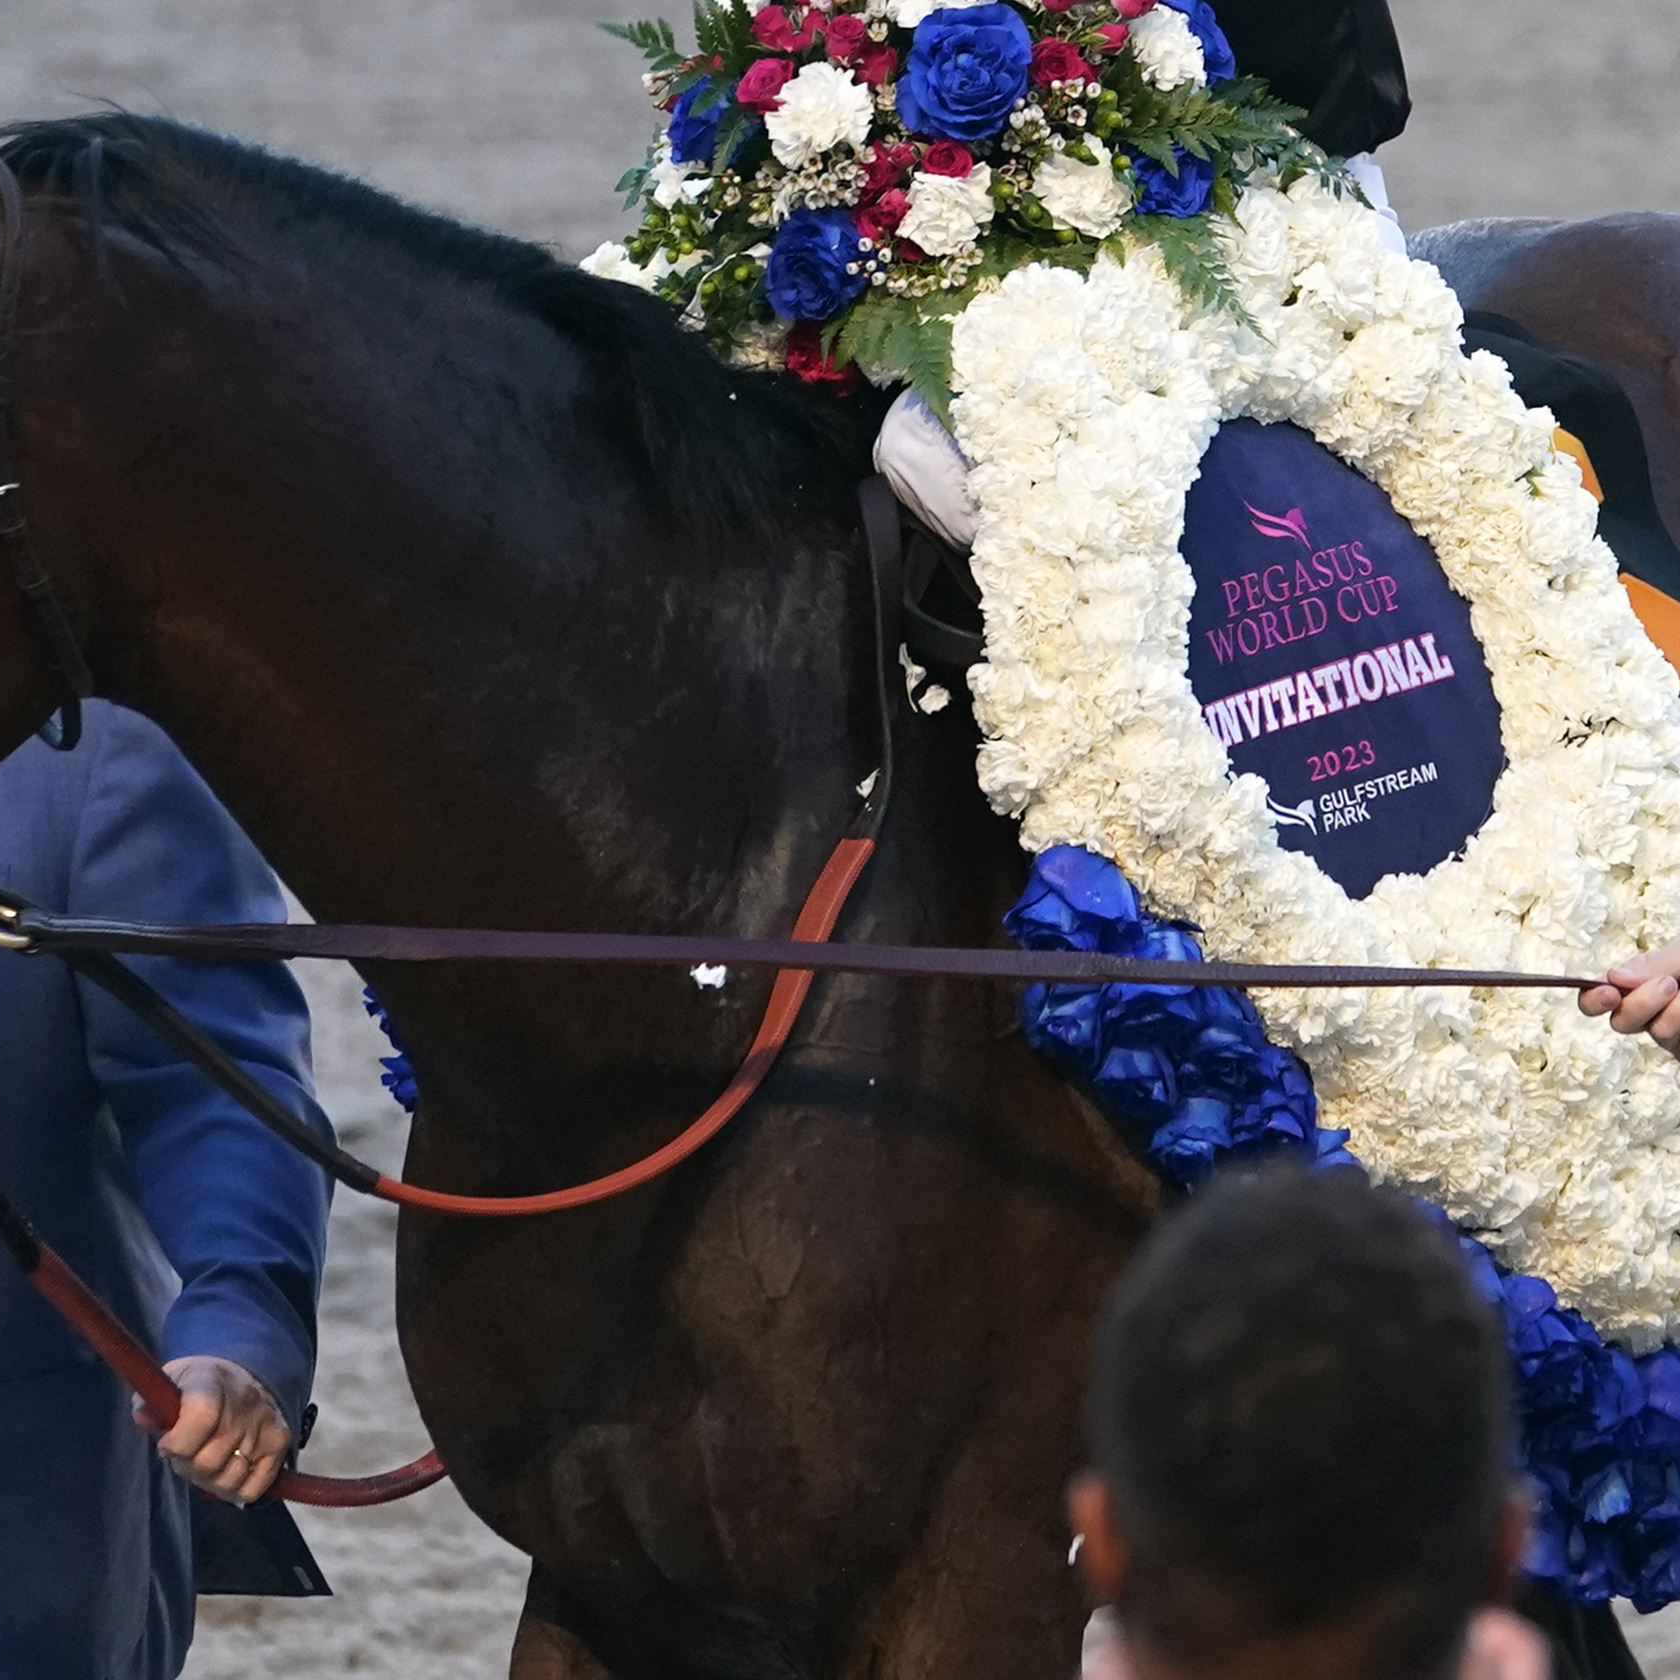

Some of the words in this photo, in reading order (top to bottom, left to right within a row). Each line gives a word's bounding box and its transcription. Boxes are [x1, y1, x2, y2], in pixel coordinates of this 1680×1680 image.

[1221, 541, 1373, 618] PEGASUS
[1205, 597, 1328, 665] WORLD
[1336, 575, 1399, 623] CUP
[1203, 632, 1456, 748] INVITATIONAL
[1306, 740, 1376, 782] 2023
[1319, 762, 1438, 812] GULFSTREAM
[1322, 801, 1371, 833] PARK
